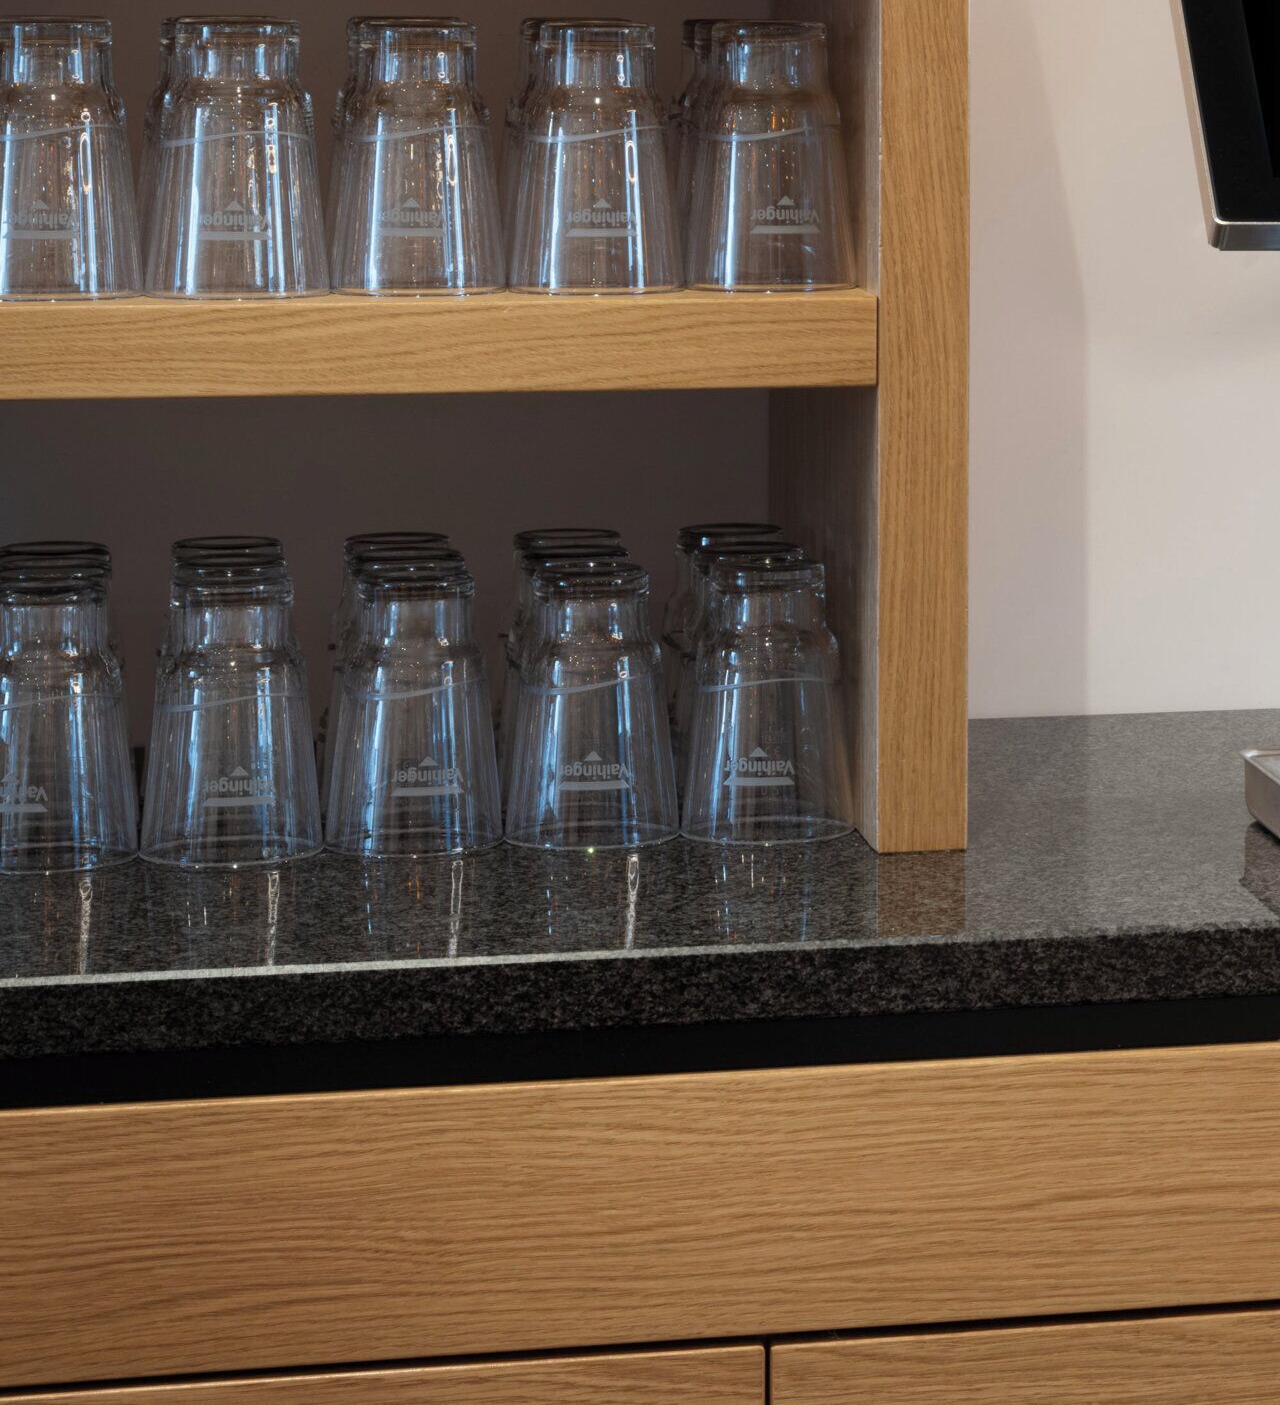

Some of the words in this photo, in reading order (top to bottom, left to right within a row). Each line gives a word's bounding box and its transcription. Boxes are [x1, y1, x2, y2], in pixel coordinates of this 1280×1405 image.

[751, 206, 820, 224] Vaihinger
[391, 767, 463, 784] Vaihinger
[724, 757, 794, 776] Vaihinger
